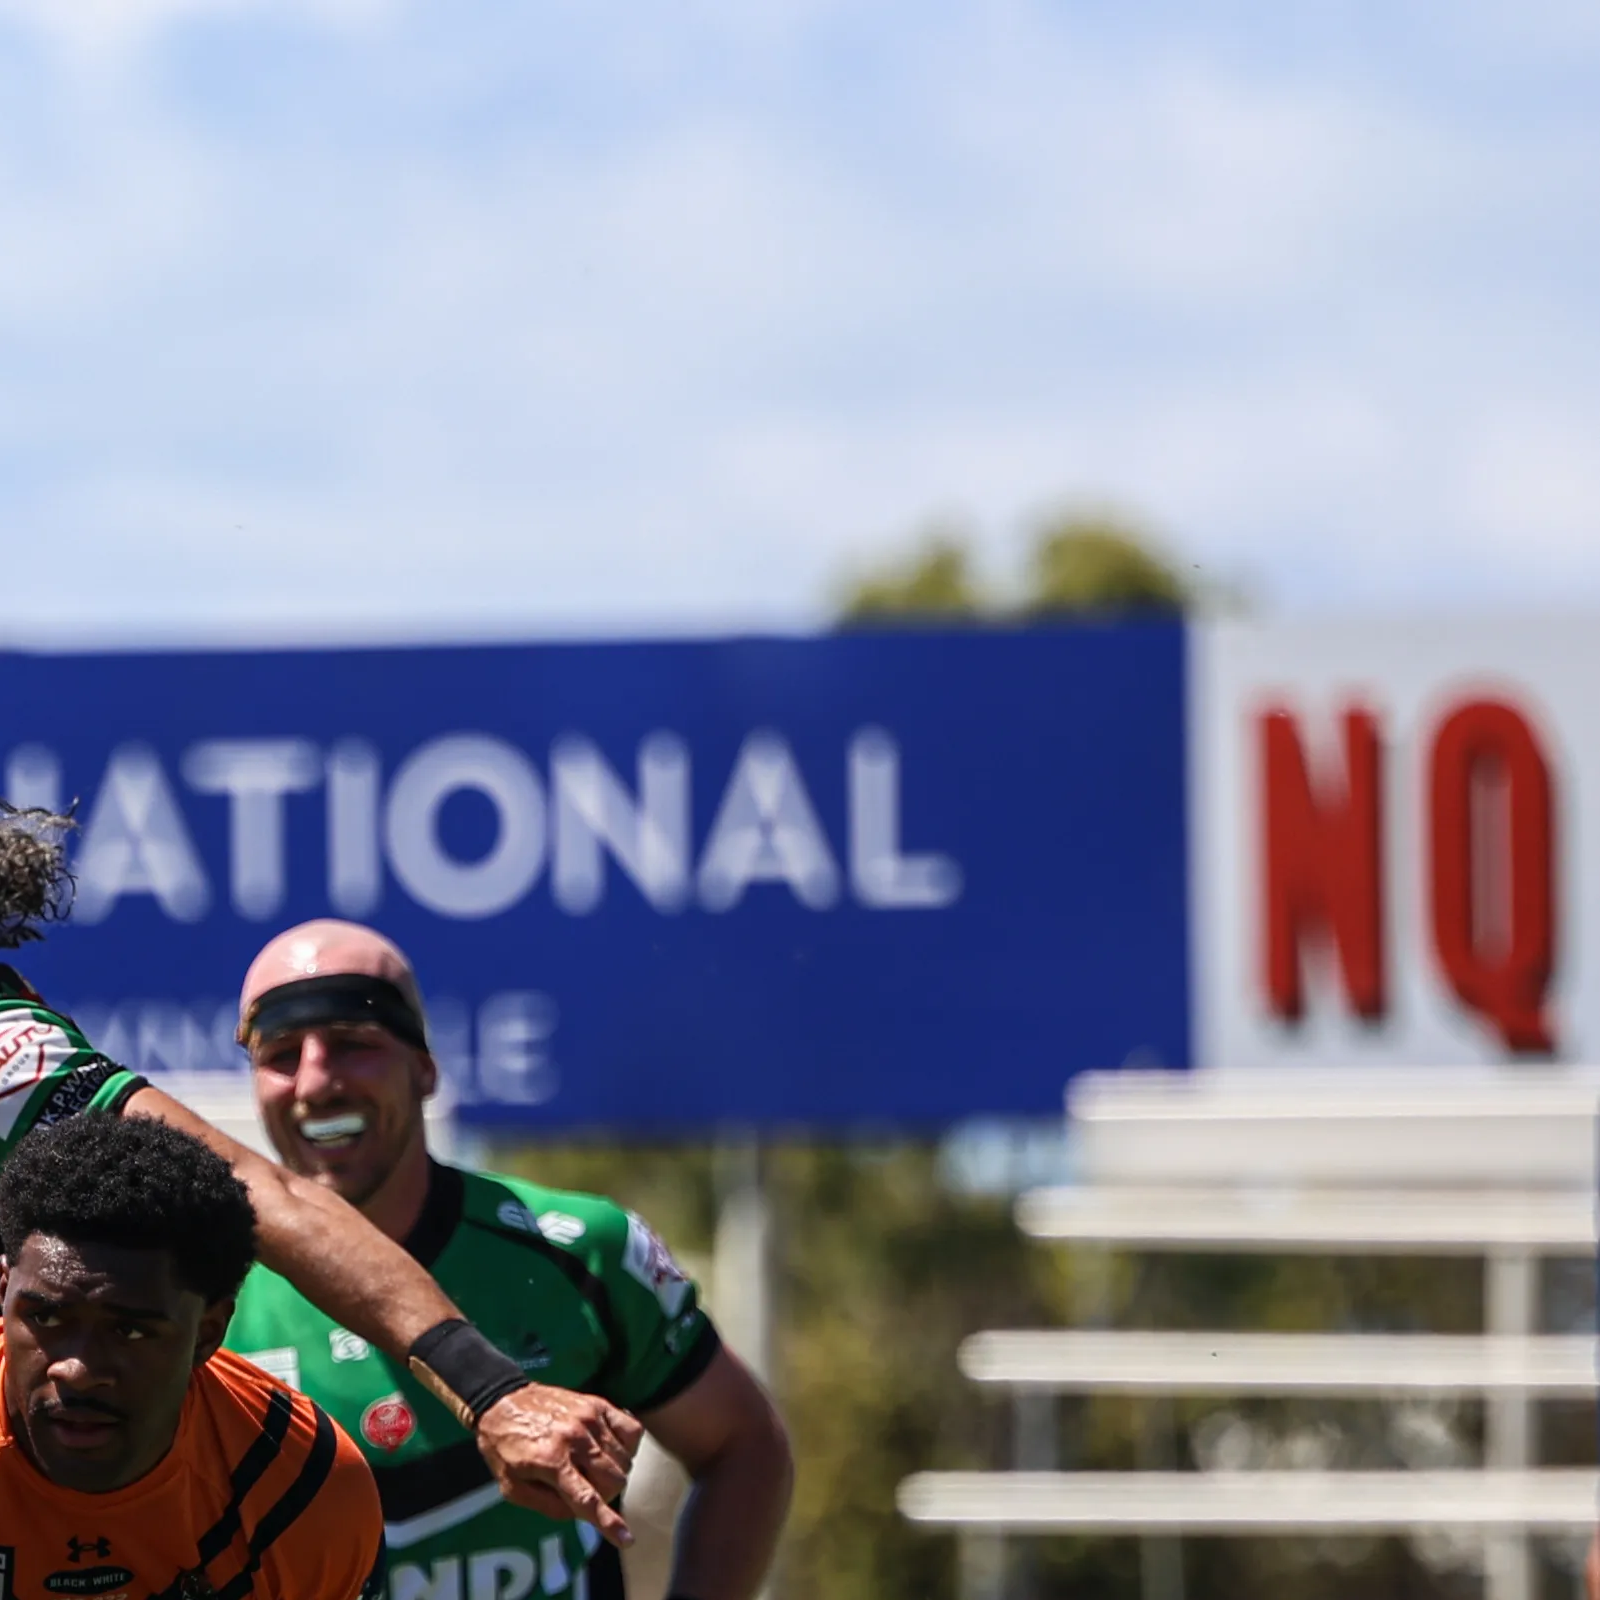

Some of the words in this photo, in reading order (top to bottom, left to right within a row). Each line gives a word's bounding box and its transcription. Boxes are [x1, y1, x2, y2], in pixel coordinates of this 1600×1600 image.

[1251, 690, 1567, 1060] NQ
[49, 1576, 86, 1588] BLACK
[92, 1572, 126, 1586] WHITE
